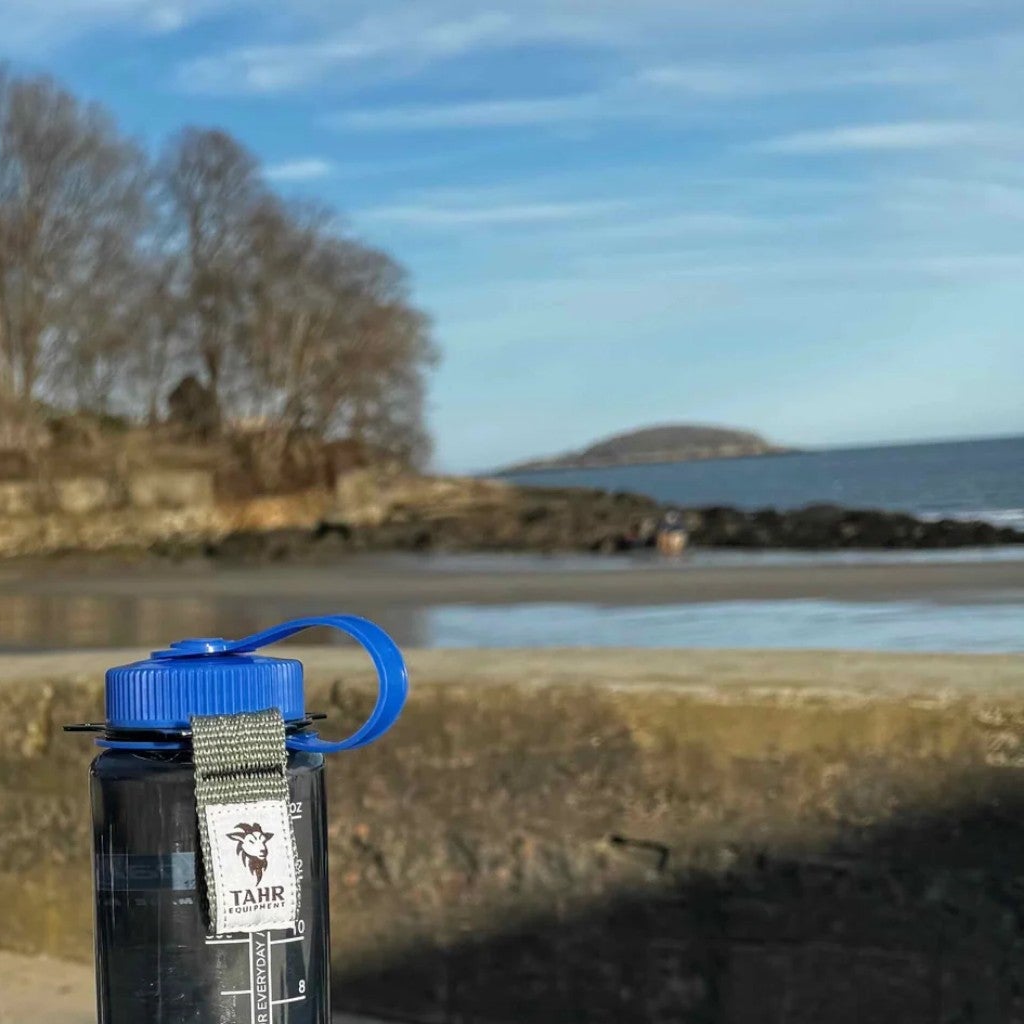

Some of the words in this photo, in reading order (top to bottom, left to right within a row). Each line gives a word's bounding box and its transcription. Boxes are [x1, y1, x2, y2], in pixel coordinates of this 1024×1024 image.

[229, 886, 285, 907] TAHR
[228, 901, 285, 914] EQUIPMENT
[256, 941, 268, 1010] EVERYDAY
[298, 979, 306, 994] 8
